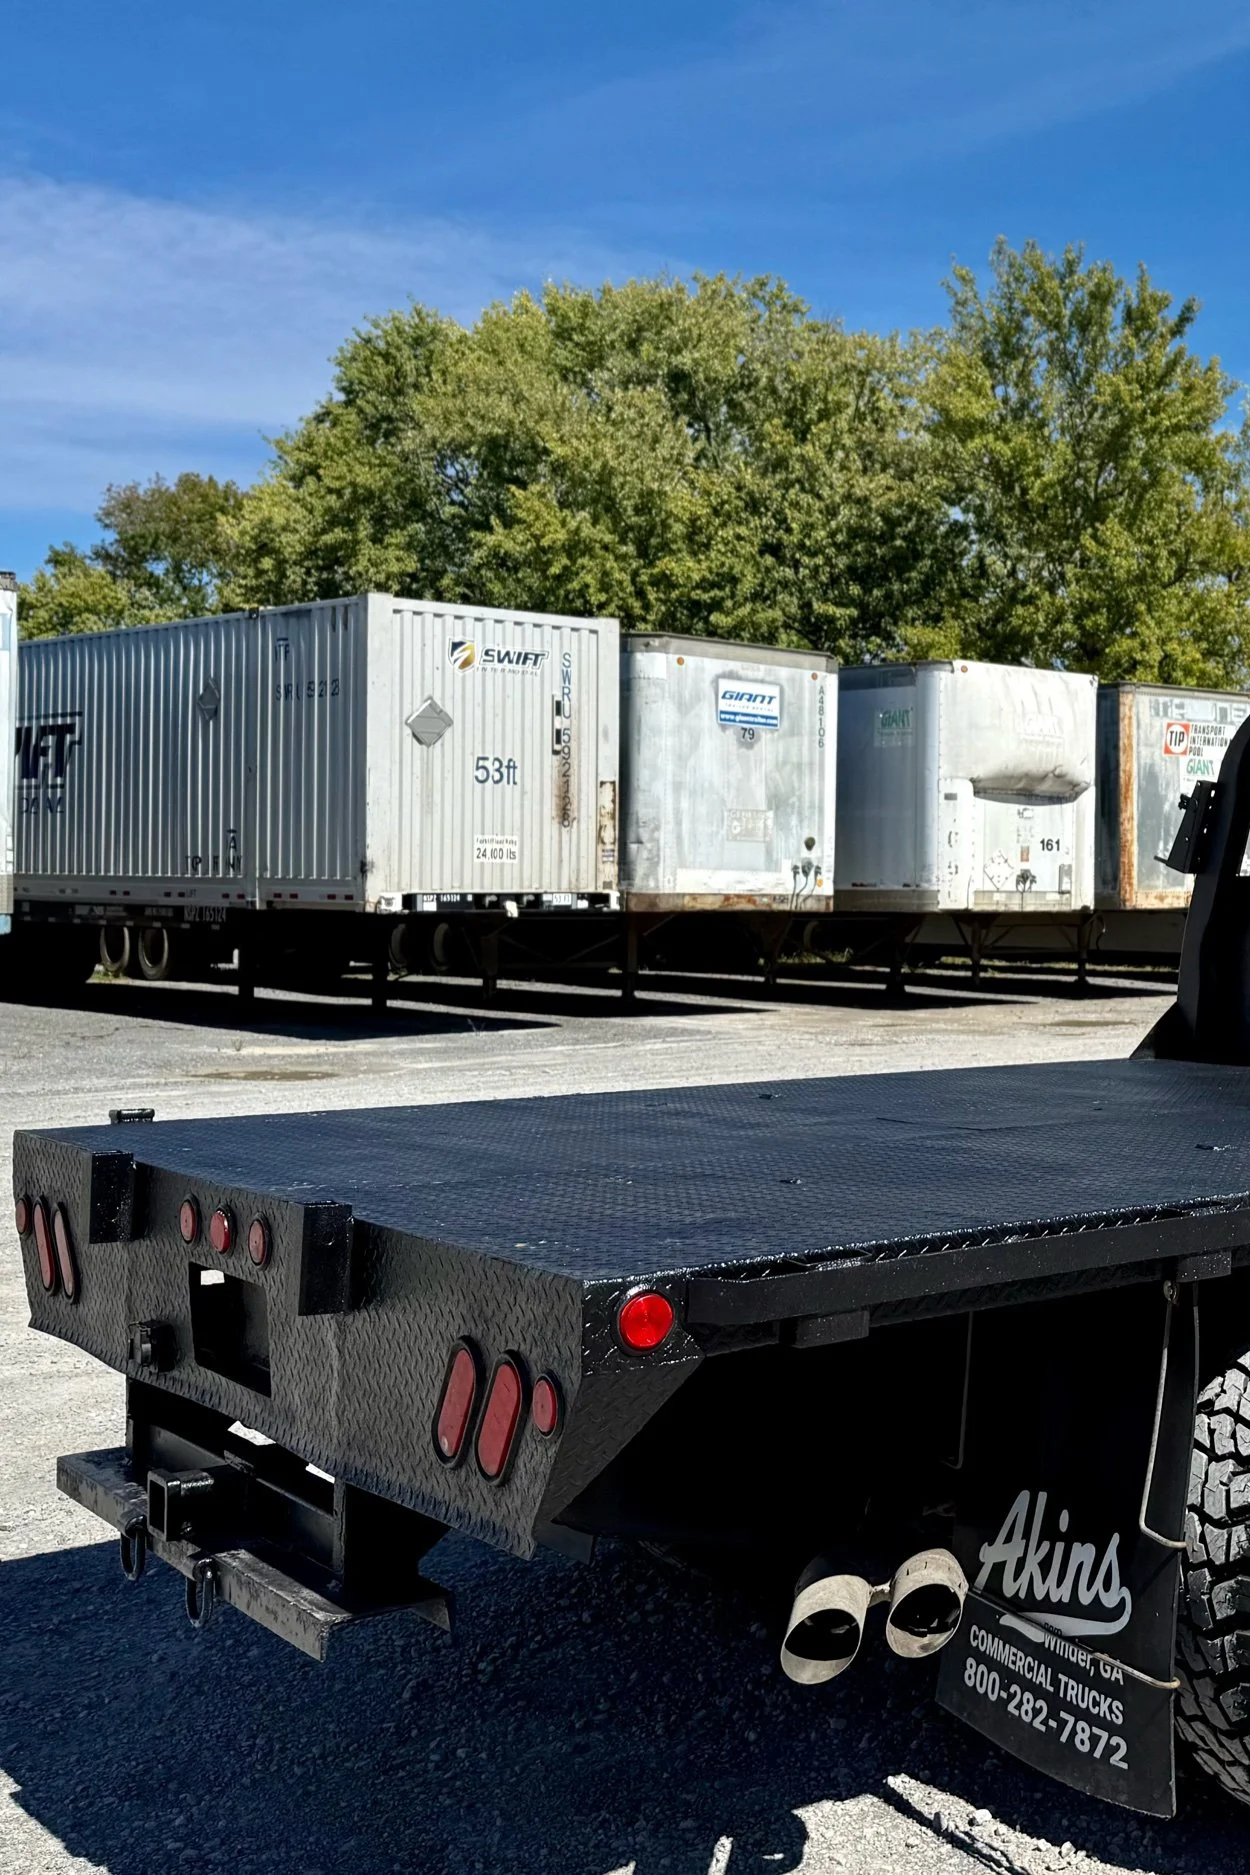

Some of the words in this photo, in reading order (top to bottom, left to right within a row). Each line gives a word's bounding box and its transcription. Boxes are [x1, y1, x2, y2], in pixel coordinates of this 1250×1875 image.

[483, 648, 546, 667] SWIFT
[721, 690, 776, 705] GIANT
[741, 727, 755, 740] 79
[1169, 730, 1185, 747] TIP
[1191, 724, 1226, 736] TRANSPORT
[1190, 736, 1232, 748] INTERNATION
[1189, 746, 1204, 757] POOL
[474, 756, 518, 785] 53ft
[1187, 759, 1215, 776] GIANT
[1040, 838, 1060, 852] 161
[974, 1490, 1132, 1612] Akins
[970, 1624, 1055, 1692] COMMERCIAL
[1058, 1673, 1124, 1725] TRUCKS
[964, 1657, 1129, 1770] 800-282-7872
